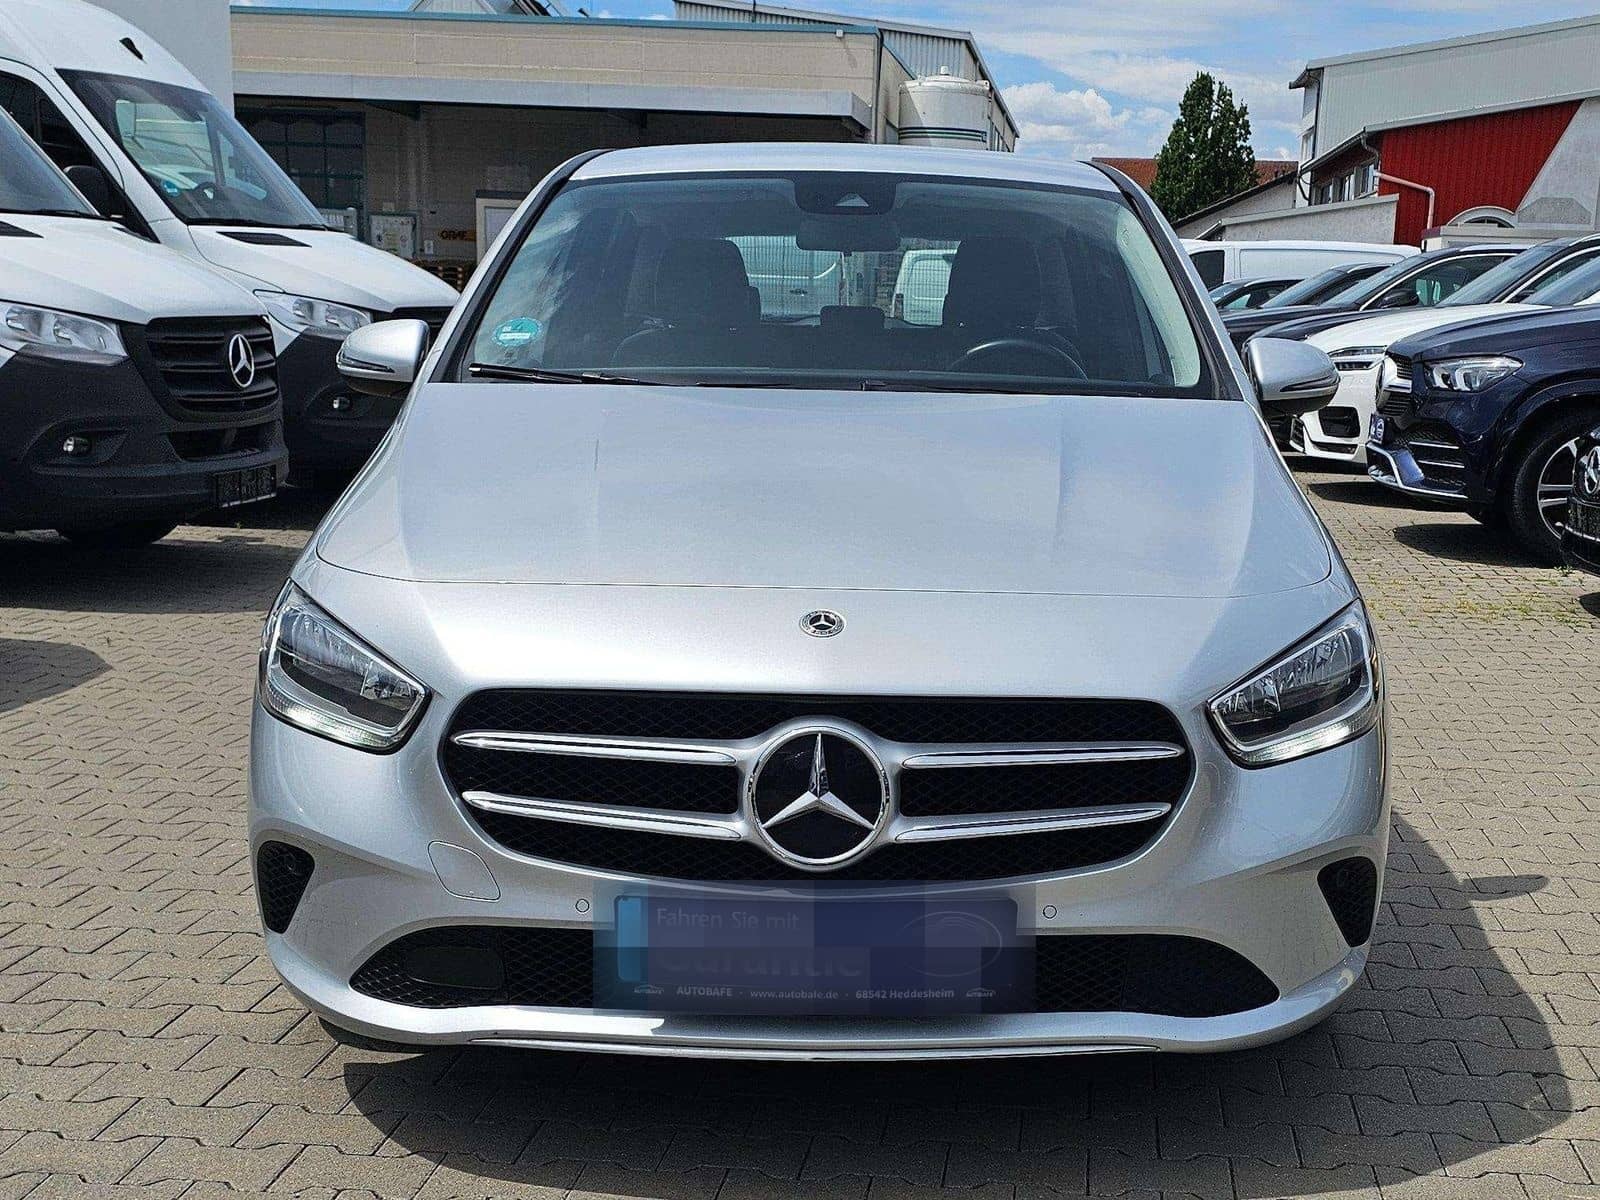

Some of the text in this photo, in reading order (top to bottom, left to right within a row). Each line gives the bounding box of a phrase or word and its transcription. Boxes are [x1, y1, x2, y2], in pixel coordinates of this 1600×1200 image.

[657, 906, 800, 929] Fahren Sie mit
[677, 985, 733, 997] AUTOBAFE
[855, 988, 888, 999] 68542
[889, 987, 955, 999] Heddesheim
